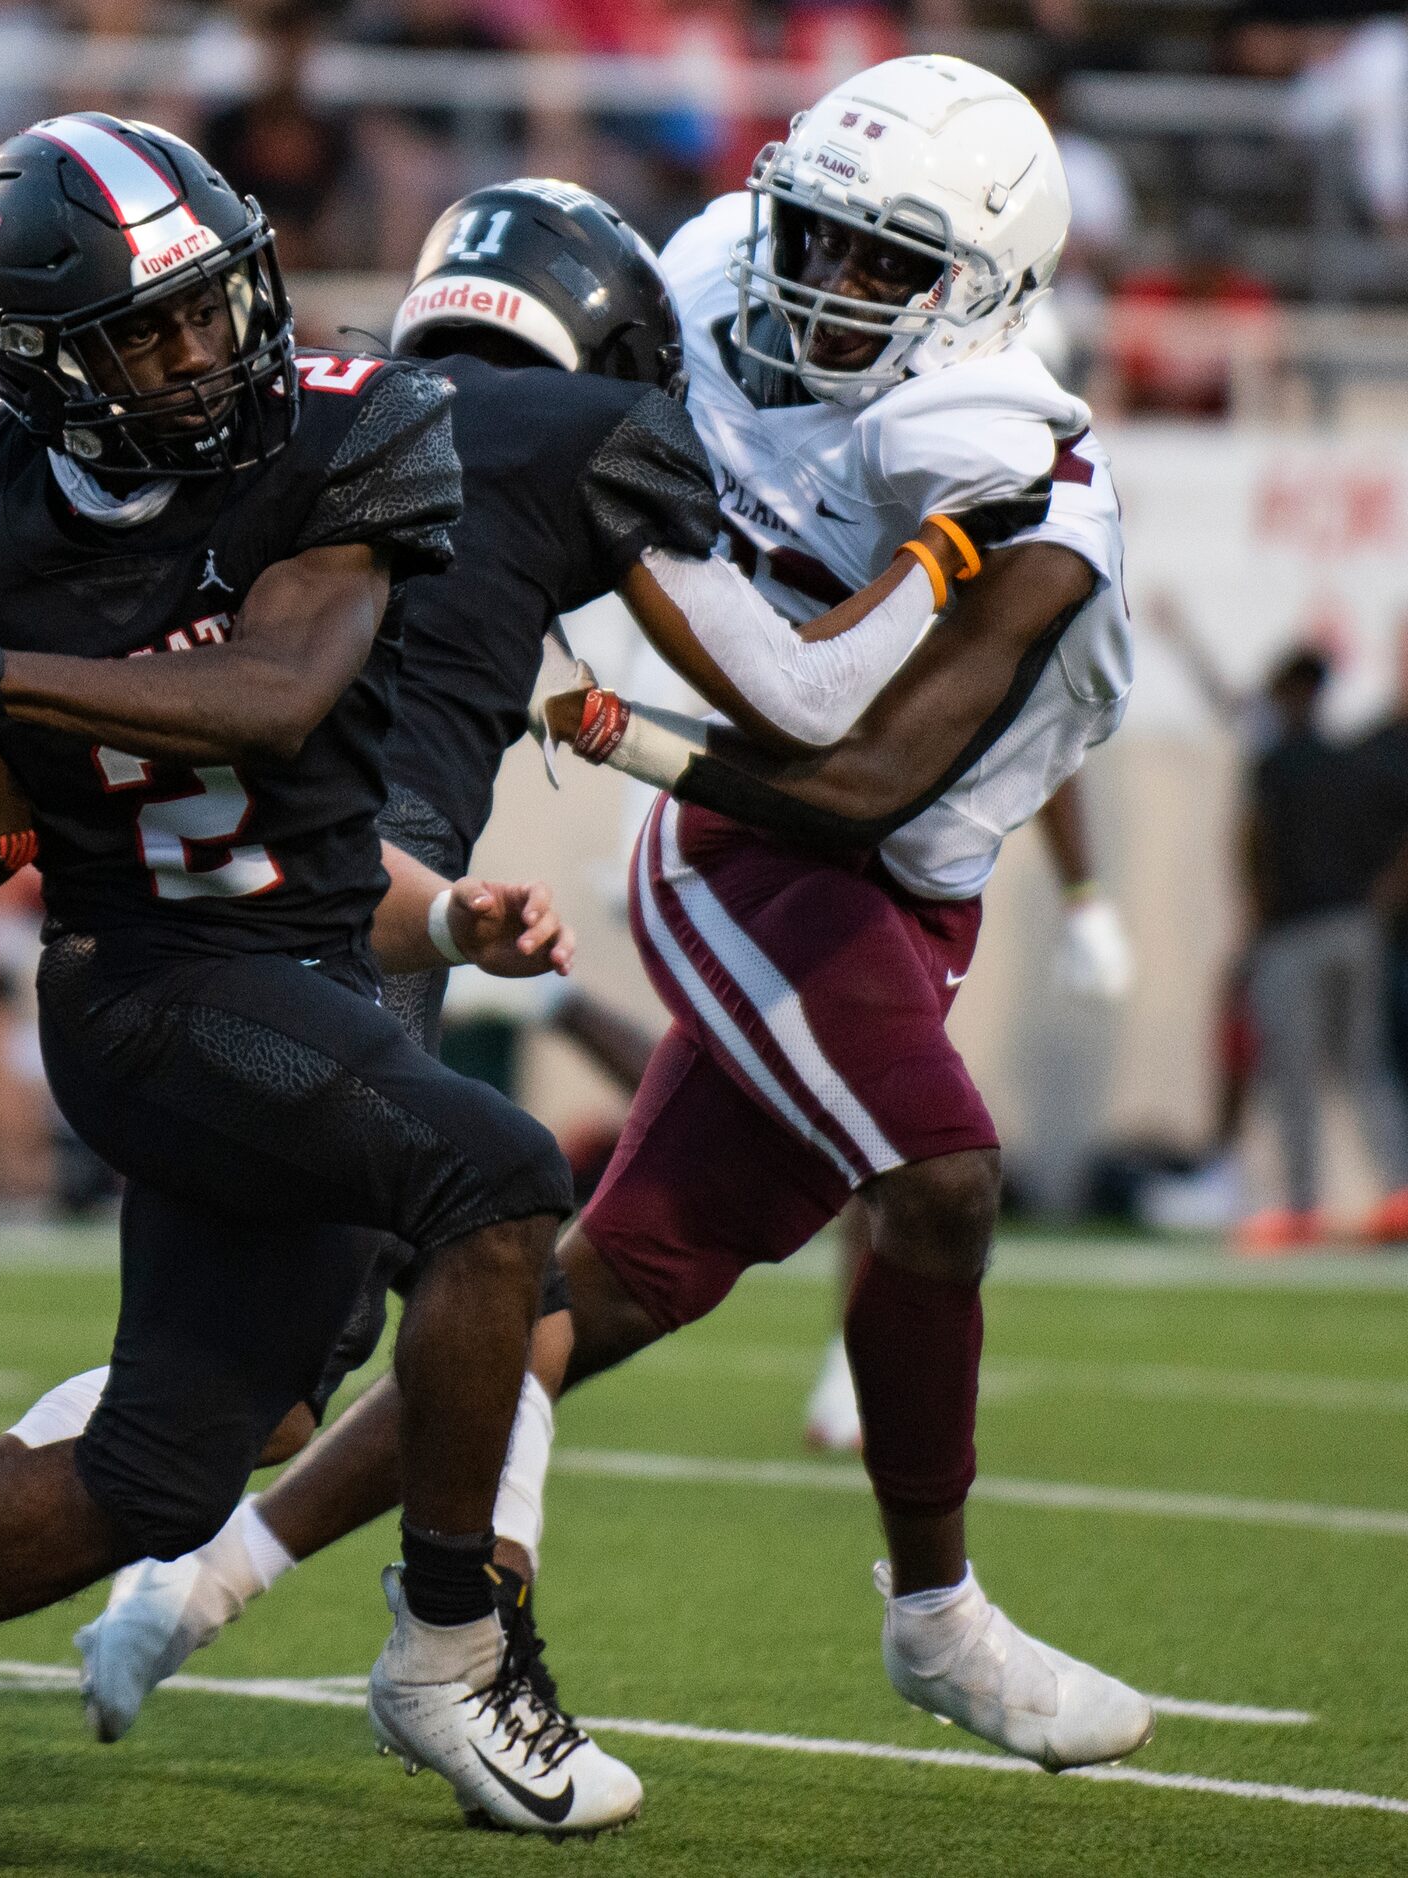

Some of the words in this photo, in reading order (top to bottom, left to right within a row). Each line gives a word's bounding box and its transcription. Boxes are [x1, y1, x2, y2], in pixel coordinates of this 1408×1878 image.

[815, 153, 856, 179] PLANO
[447, 210, 513, 254] 11
[402, 283, 522, 322] Riddell
[919, 263, 963, 310] Riddll
[292, 355, 385, 397] 2
[91, 745, 286, 901] 2
